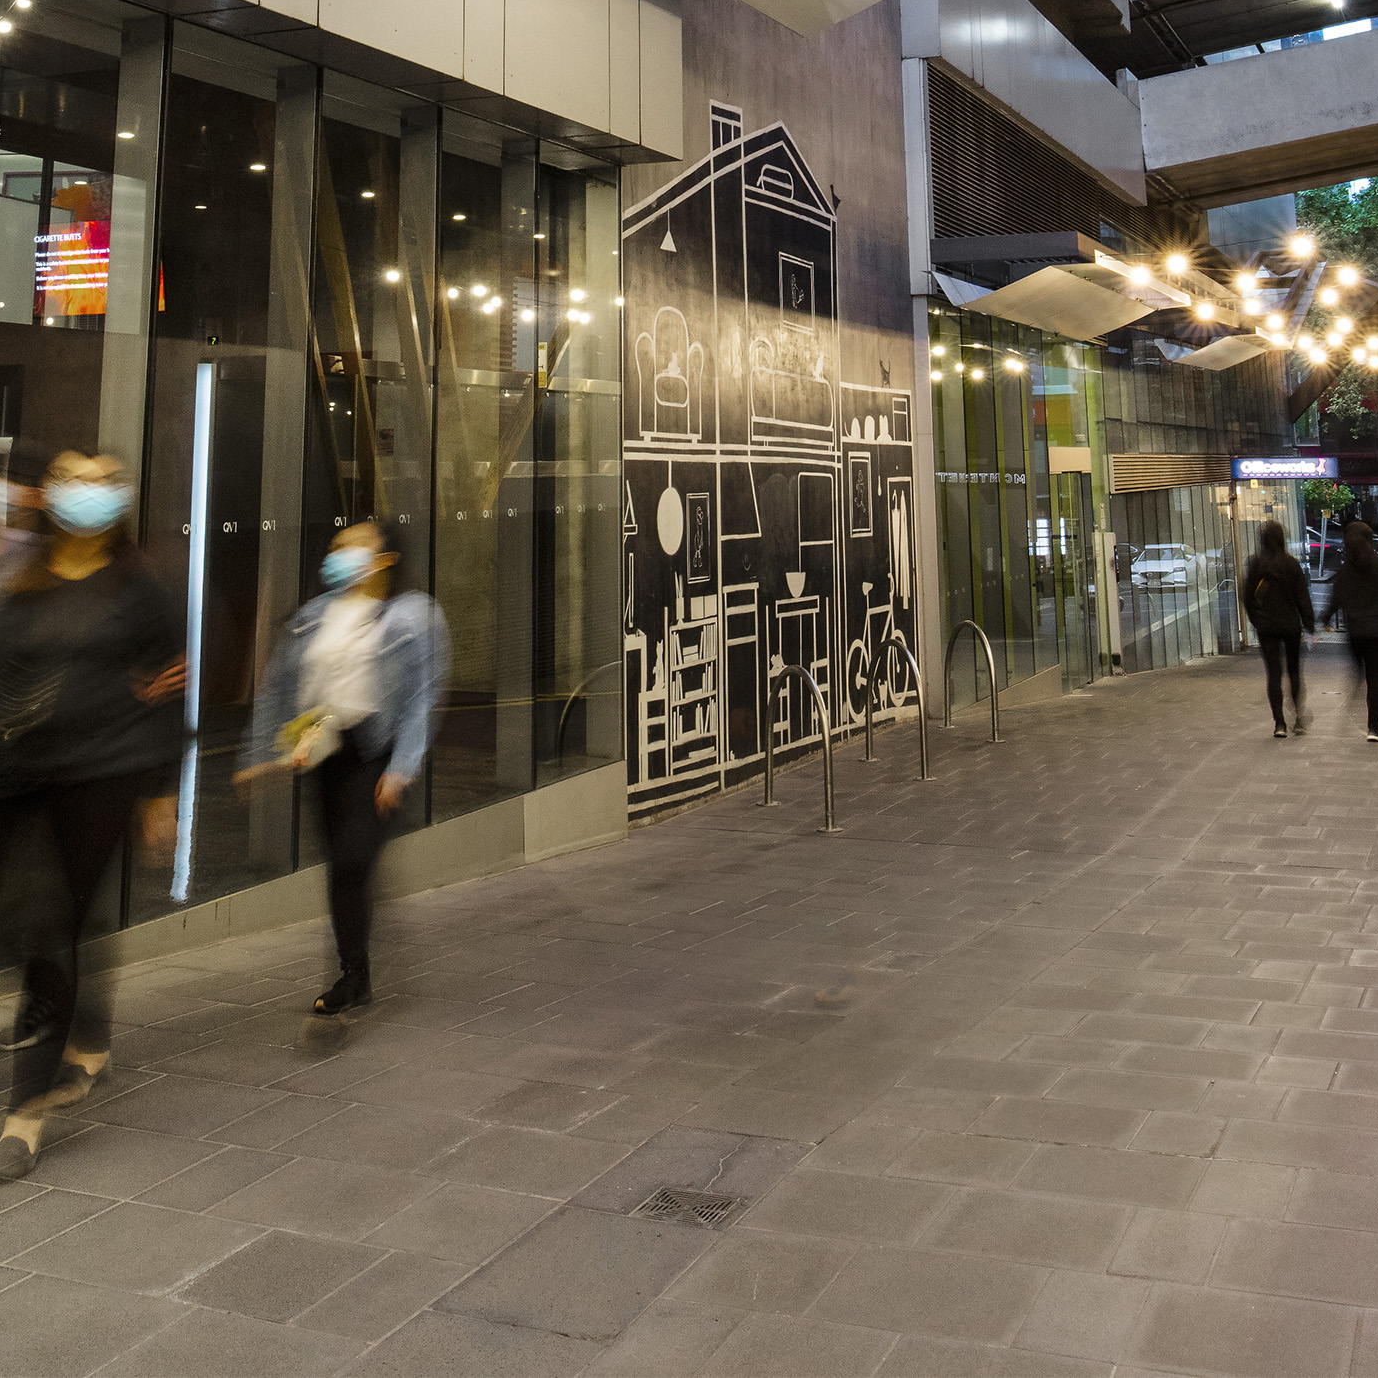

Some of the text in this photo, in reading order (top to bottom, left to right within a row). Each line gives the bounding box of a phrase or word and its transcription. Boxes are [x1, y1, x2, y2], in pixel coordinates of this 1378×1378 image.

[64, 232, 81, 241] BUTTS
[223, 522, 237, 532] QV1
[262, 520, 276, 530] QV1
